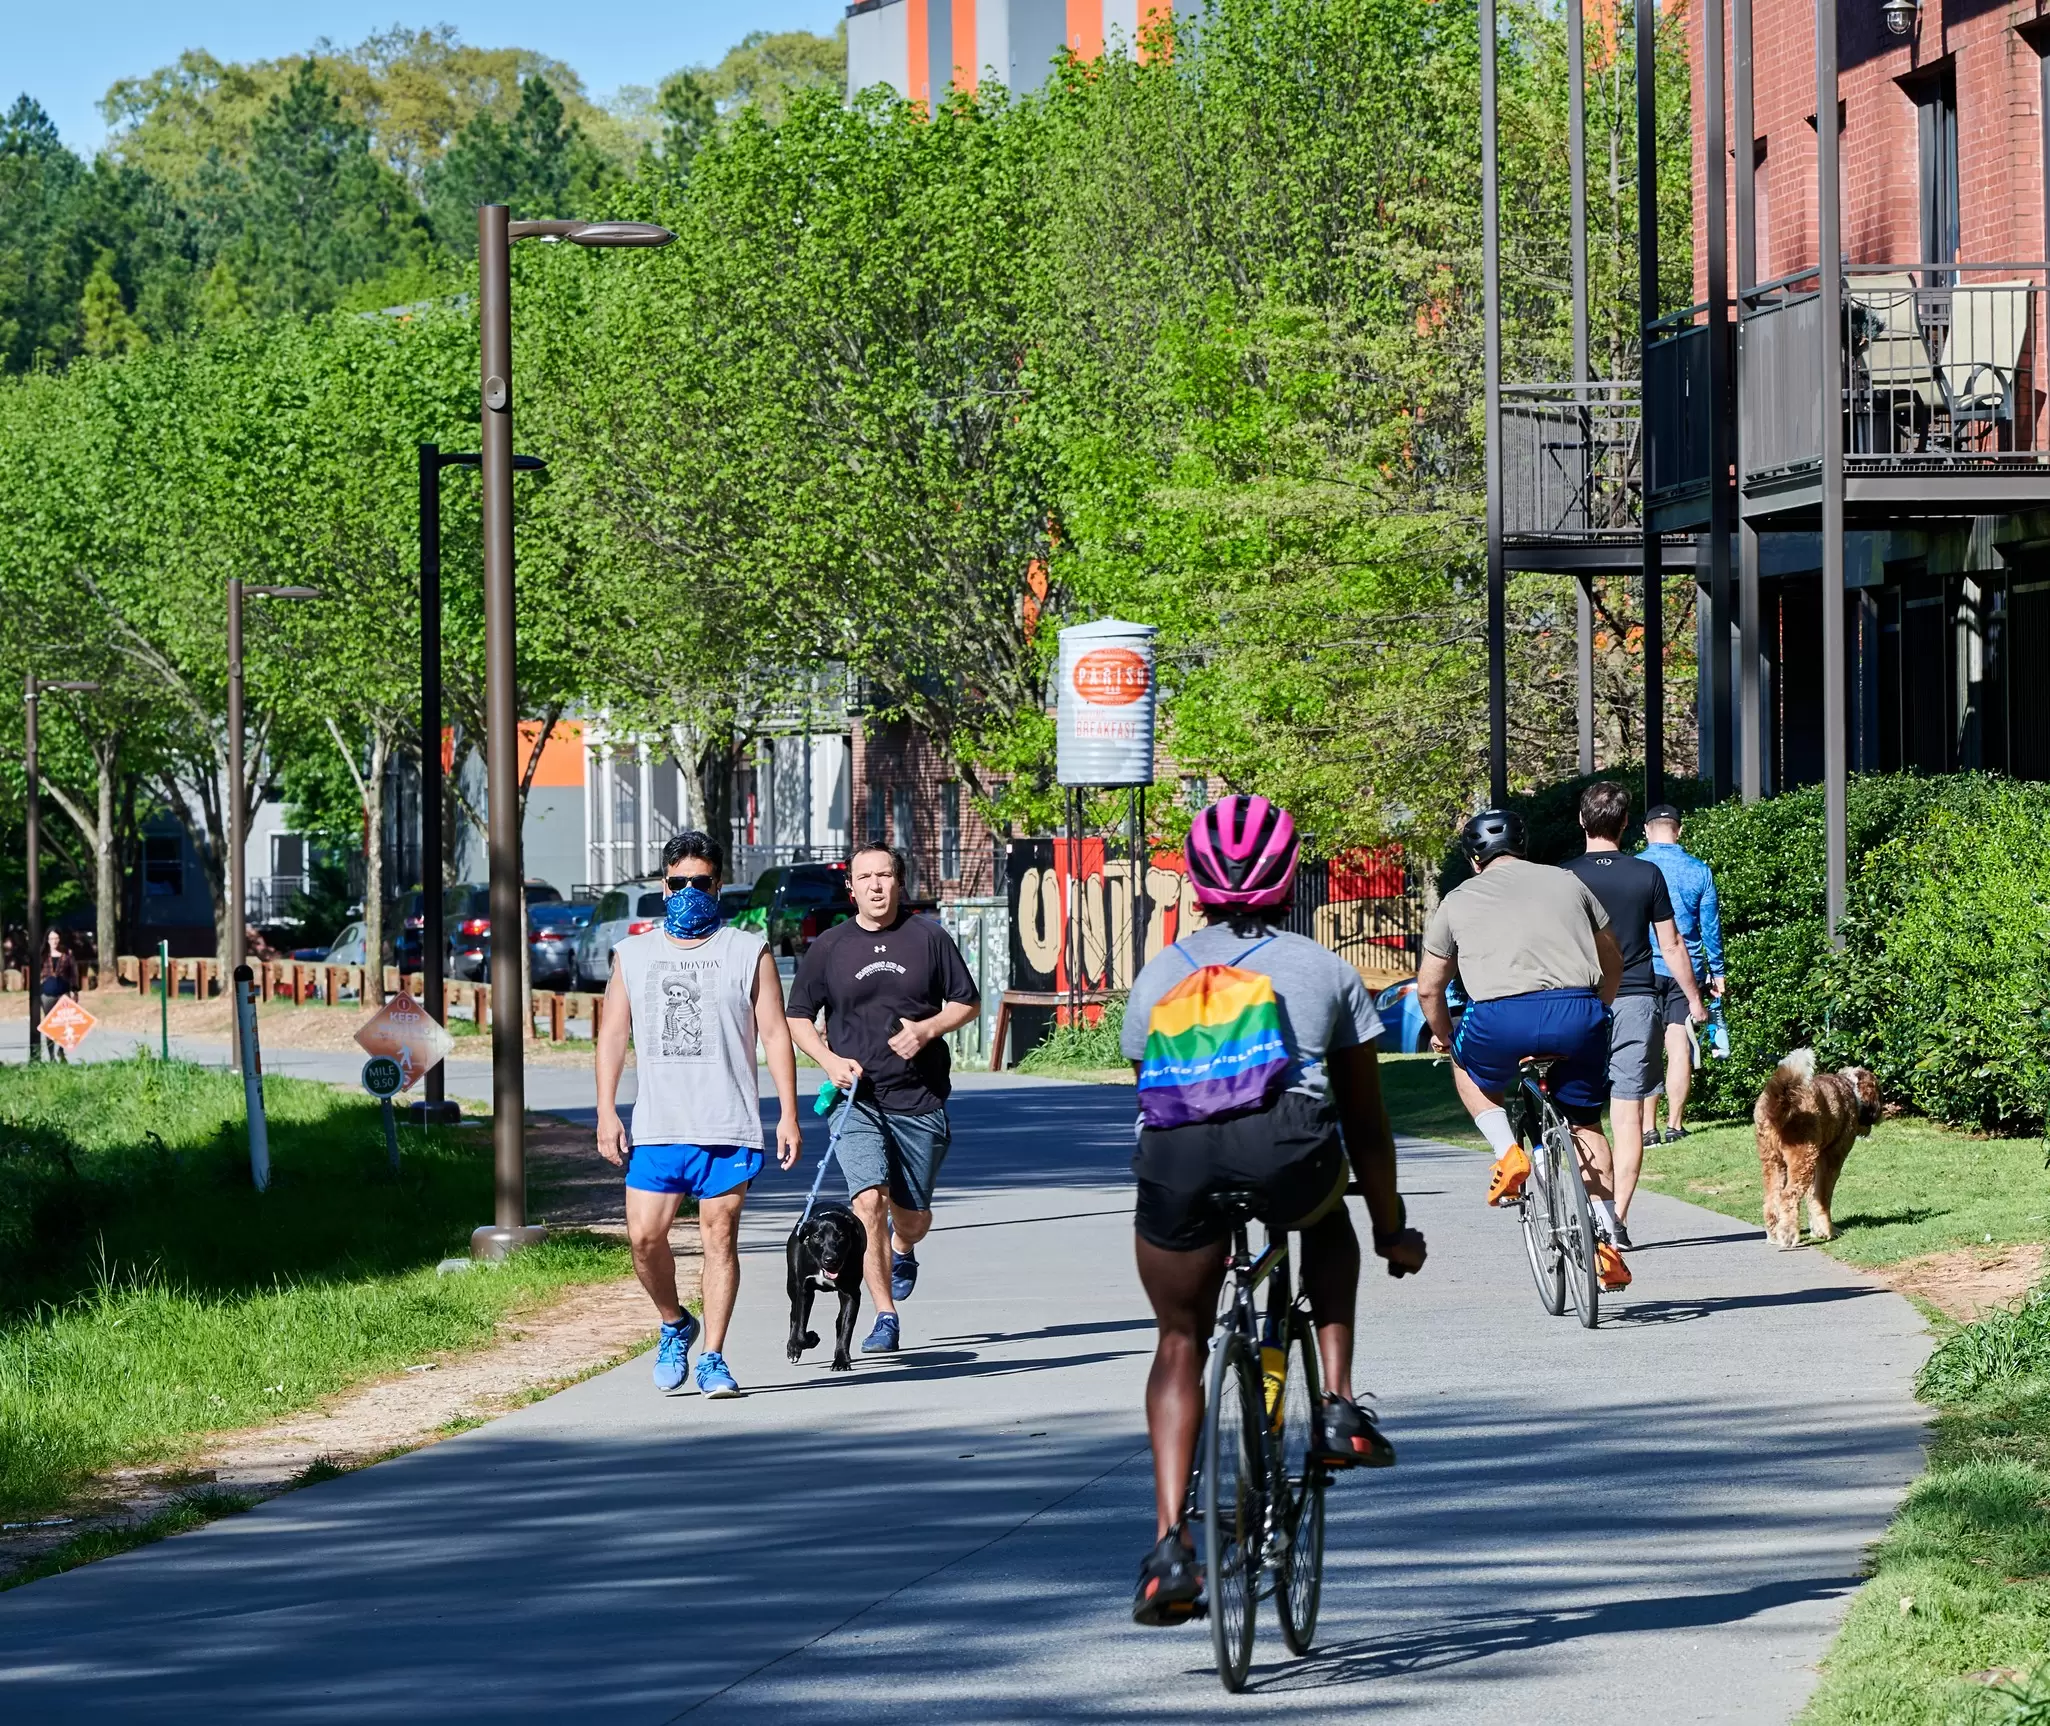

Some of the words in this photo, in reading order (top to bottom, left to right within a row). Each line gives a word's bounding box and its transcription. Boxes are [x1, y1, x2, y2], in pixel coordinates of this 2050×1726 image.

[1078, 666, 1145, 686] PARISH
[1076, 720, 1137, 738] BREAKFAST
[389, 1011, 420, 1024] KEEP
[1140, 1065, 1193, 1079] UNITED
[1212, 1039, 1284, 1065] AIRLINES
[369, 1064, 397, 1078] MILE
[373, 1078, 394, 1089] 9.50
